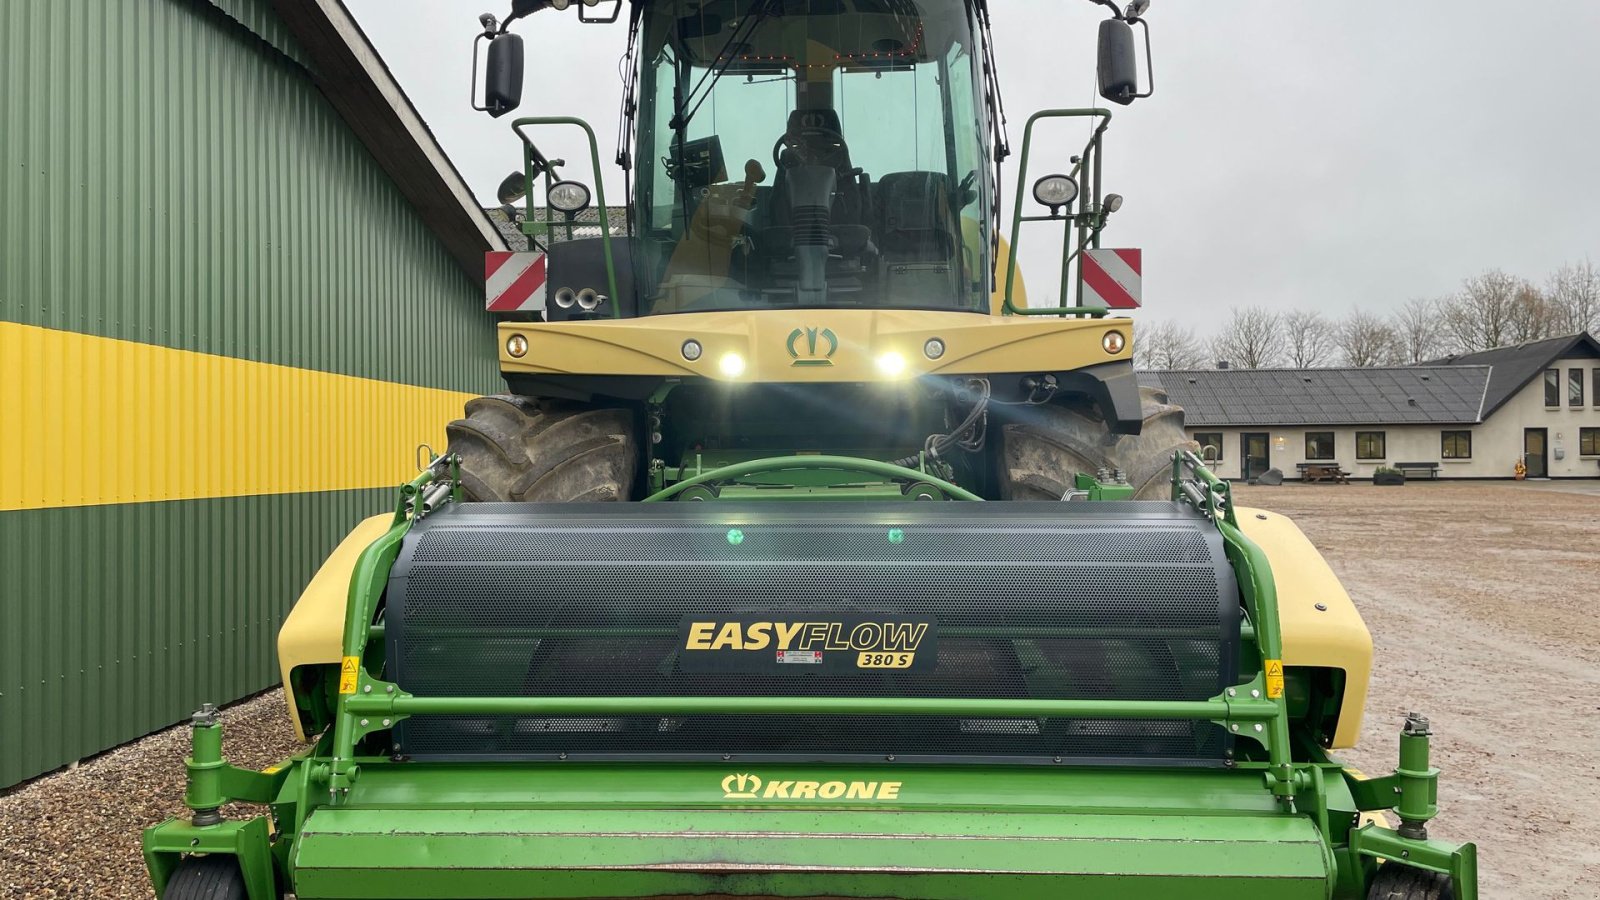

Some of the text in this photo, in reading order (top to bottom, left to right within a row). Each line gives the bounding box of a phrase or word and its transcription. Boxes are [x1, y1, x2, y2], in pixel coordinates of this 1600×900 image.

[685, 622, 928, 651] EASYFLOW
[862, 654, 909, 666] 380 S
[762, 780, 903, 800] KRONE
